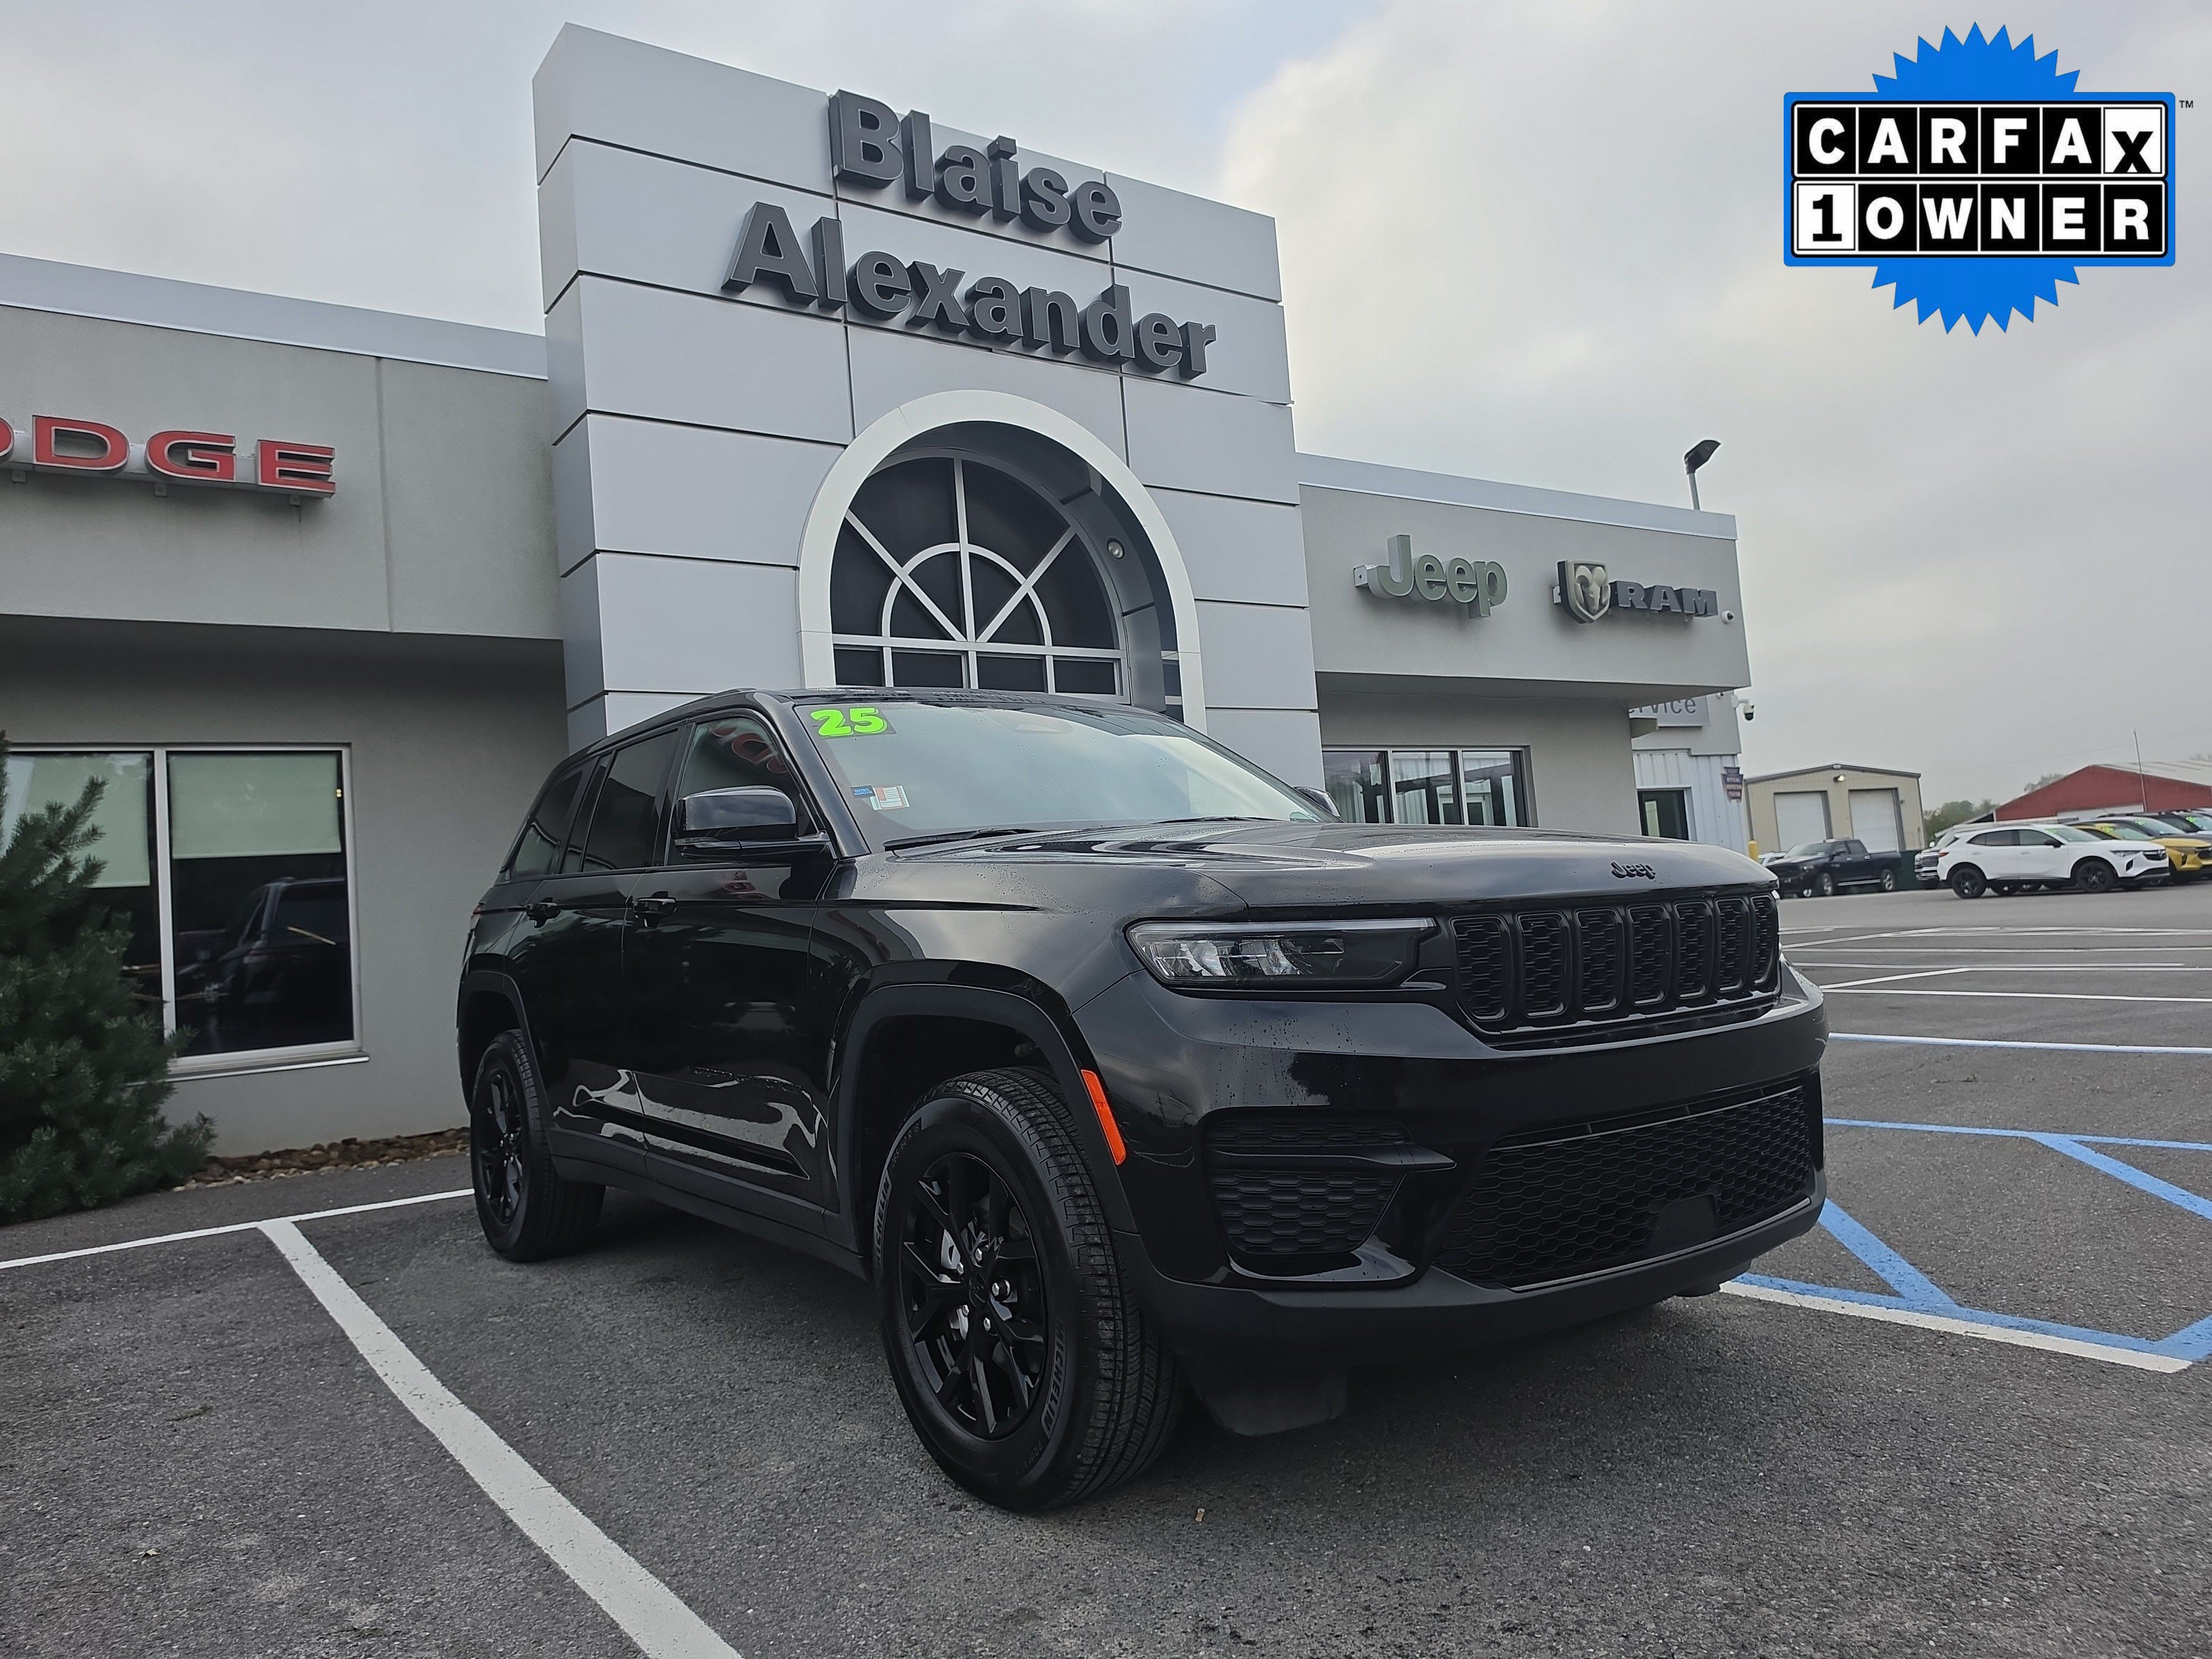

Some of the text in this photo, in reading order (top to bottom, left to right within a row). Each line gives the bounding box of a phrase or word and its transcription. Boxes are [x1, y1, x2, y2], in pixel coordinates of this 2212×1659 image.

[829, 89, 1123, 244] Blaise
[721, 201, 1217, 380] Alexander
[0, 415, 337, 499] DGE
[1366, 534, 1508, 619] Jeep
[1610, 580, 1719, 618] RAM
[810, 708, 888, 738] 25
[1610, 861, 1656, 880] Jeep
[1043, 1319, 1065, 1432] MICHELIN
